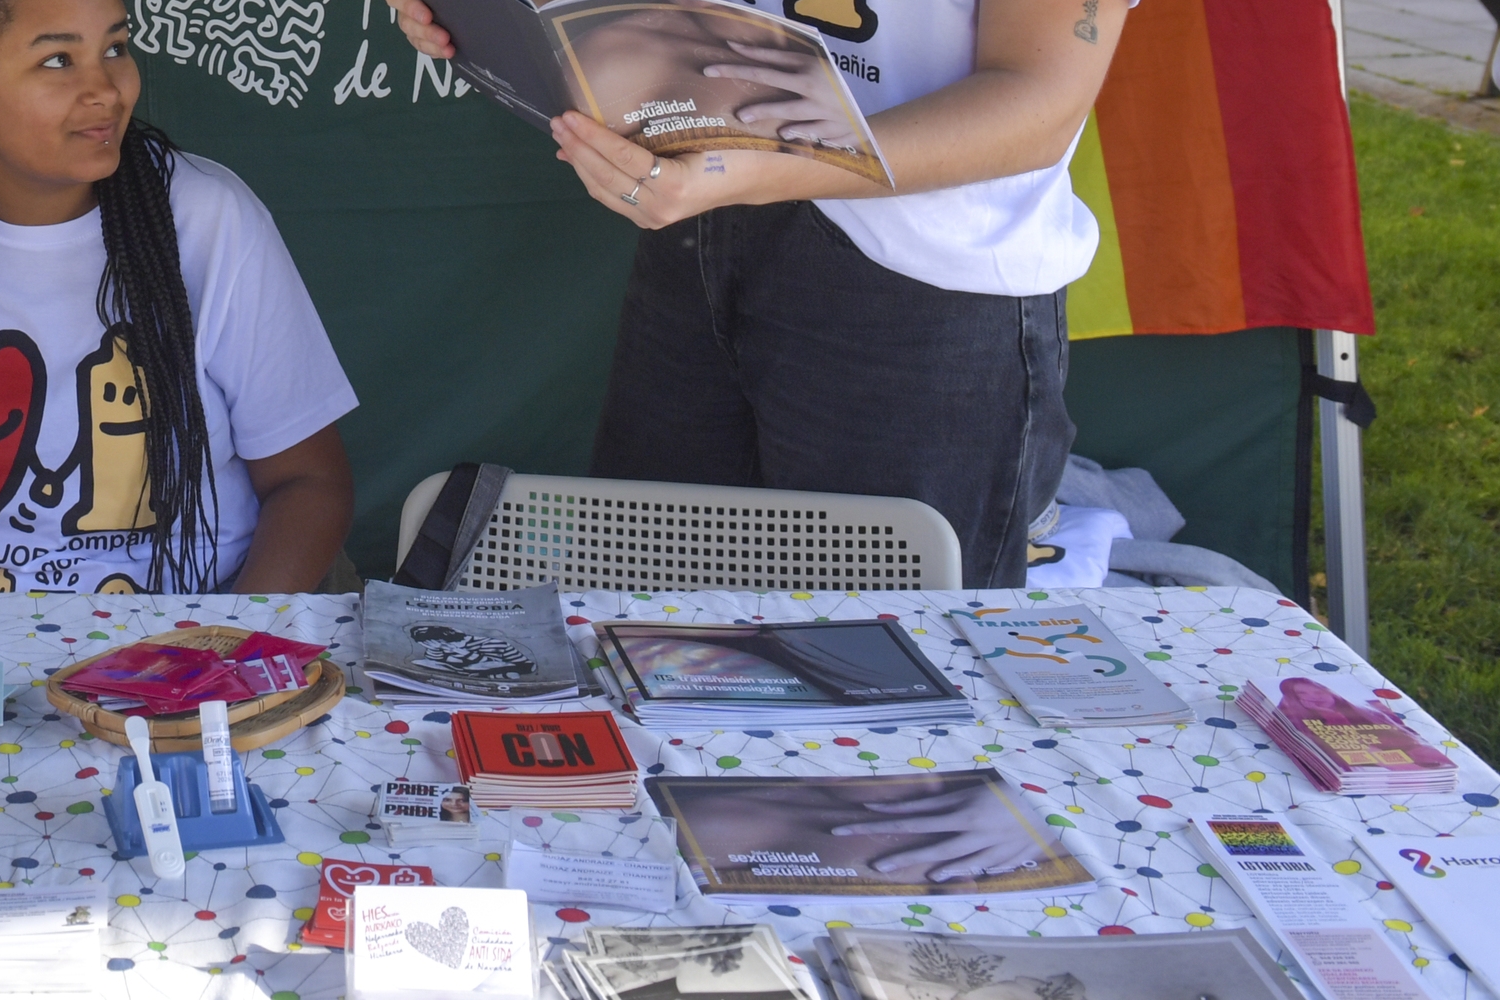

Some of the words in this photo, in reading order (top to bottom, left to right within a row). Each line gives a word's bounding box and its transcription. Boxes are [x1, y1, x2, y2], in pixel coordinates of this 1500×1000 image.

[334, 39, 392, 105] de
[623, 98, 697, 125] sexualidad
[643, 115, 726, 138] sexualitatea
[406, 600, 524, 611] LGTBIFOBIA
[654, 674, 676, 682] ITS
[677, 674, 755, 685] transmisión
[757, 675, 802, 685] sexual
[659, 683, 692, 692] sexu
[501, 732, 595, 768] CON
[386, 782, 439, 797] PRIDE
[384, 804, 439, 818] PRIDE
[728, 852, 820, 863] sexualidad
[751, 865, 858, 877] sexualitatea
[1237, 861, 1316, 871] LGTBIFOBIA
[469, 946, 490, 960] ANTI
[492, 946, 512, 963] SIDA
[465, 962, 473, 970] de
[477, 962, 512, 971] Navarra
